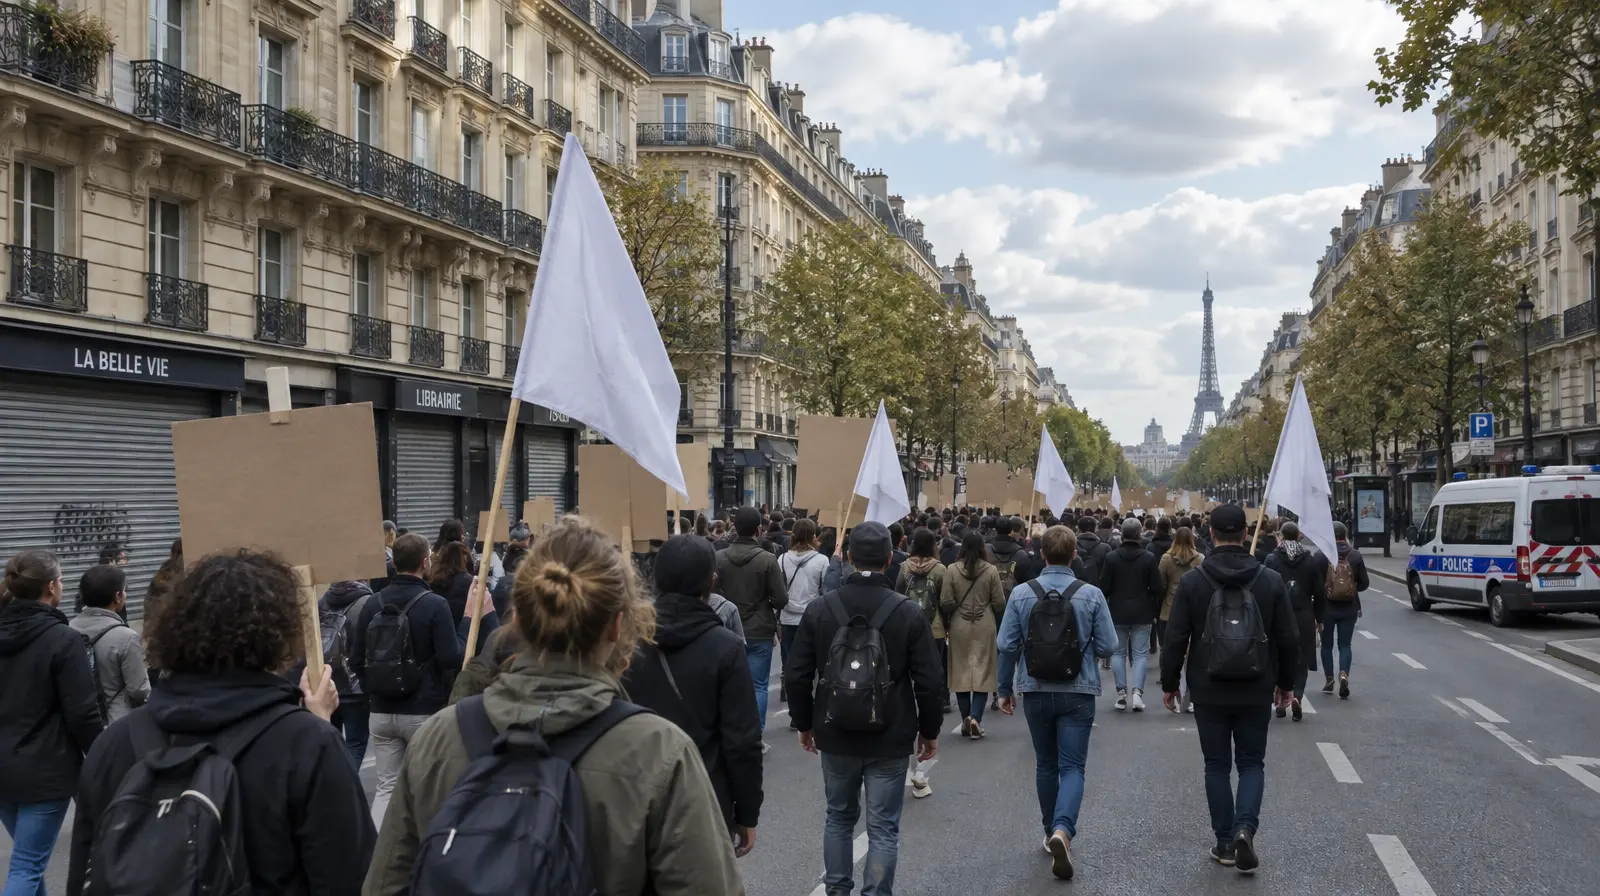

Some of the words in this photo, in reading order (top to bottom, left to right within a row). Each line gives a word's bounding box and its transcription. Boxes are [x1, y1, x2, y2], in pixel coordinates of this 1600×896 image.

[74, 347, 94, 369] LA
[99, 350, 143, 374] BELLE
[147, 356, 169, 377] VIE
[1475, 416, 1488, 434] P
[1442, 557, 1473, 572] POLICE
